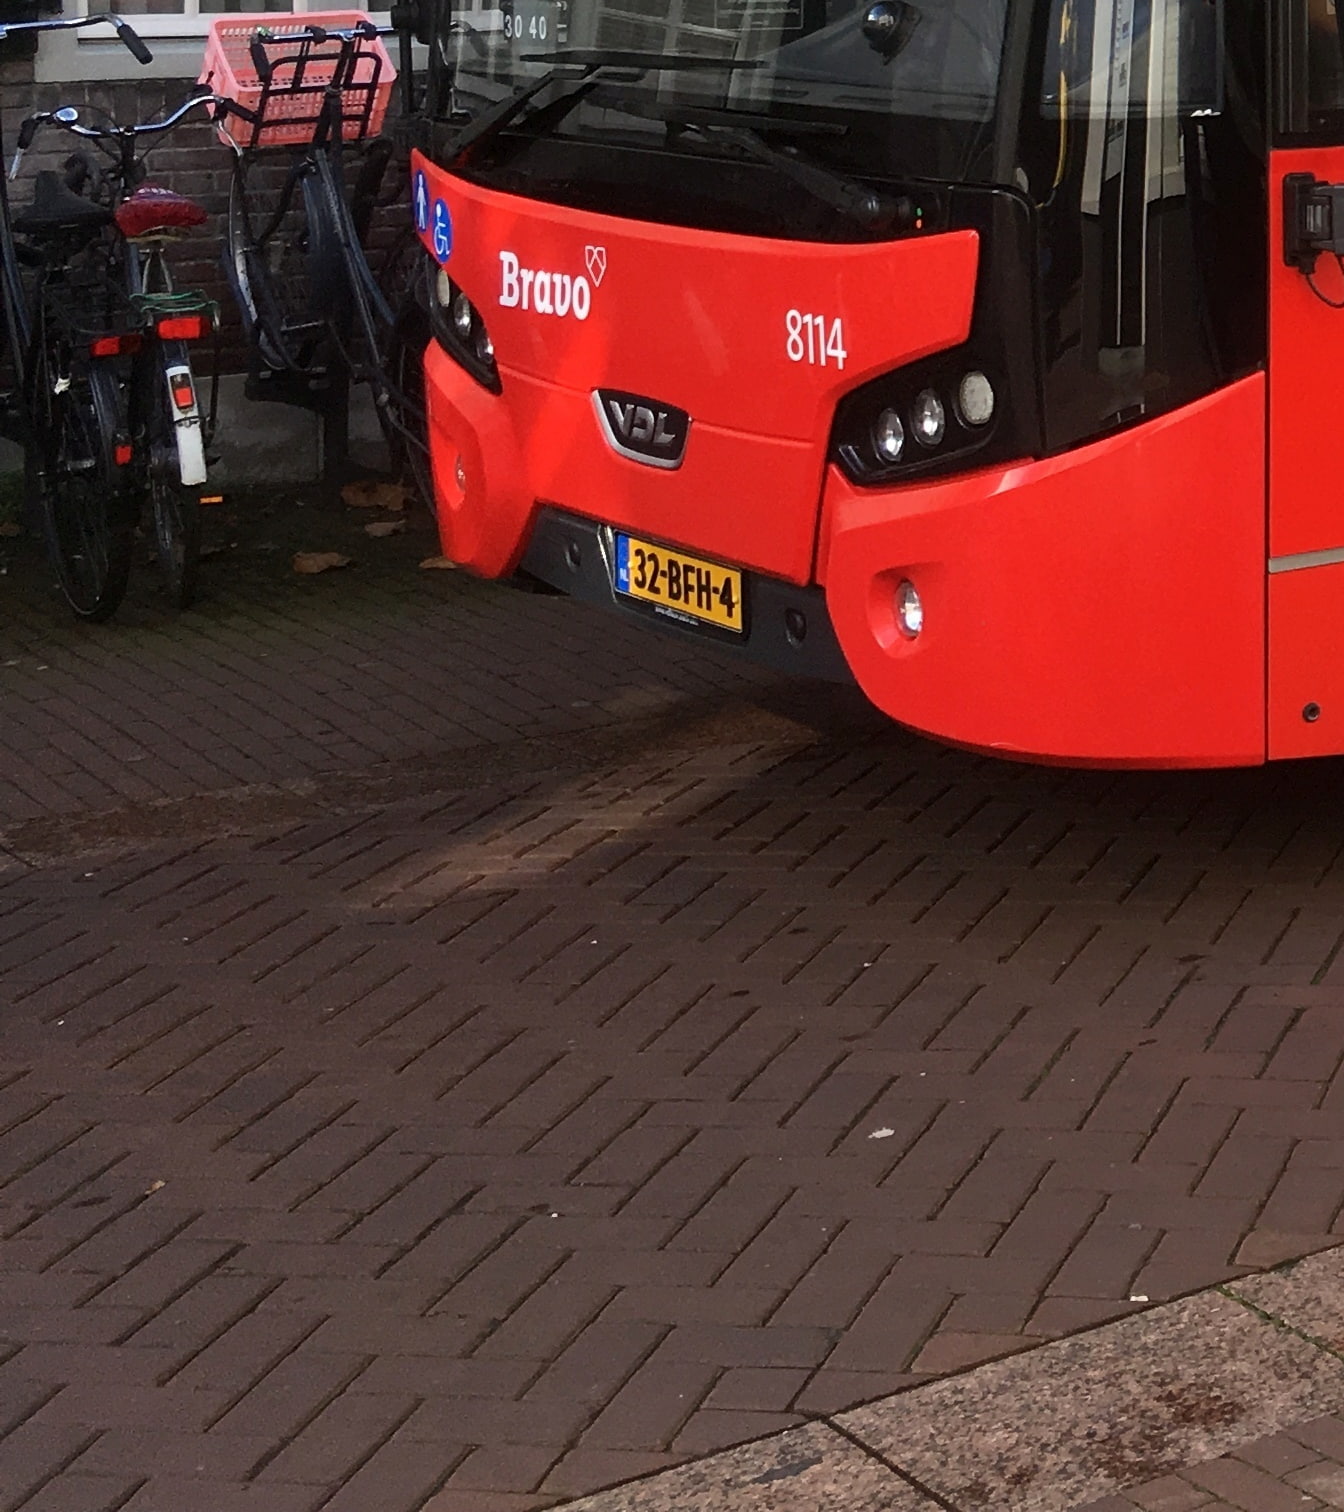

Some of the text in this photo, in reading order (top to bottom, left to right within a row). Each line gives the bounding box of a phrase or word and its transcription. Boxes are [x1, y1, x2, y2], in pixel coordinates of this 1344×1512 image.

[529, 15, 547, 40] 40
[499, 251, 591, 320] Bravo
[786, 309, 847, 370] 8114
[609, 399, 676, 446] VDL
[634, 548, 736, 619] 32-BFH-4
